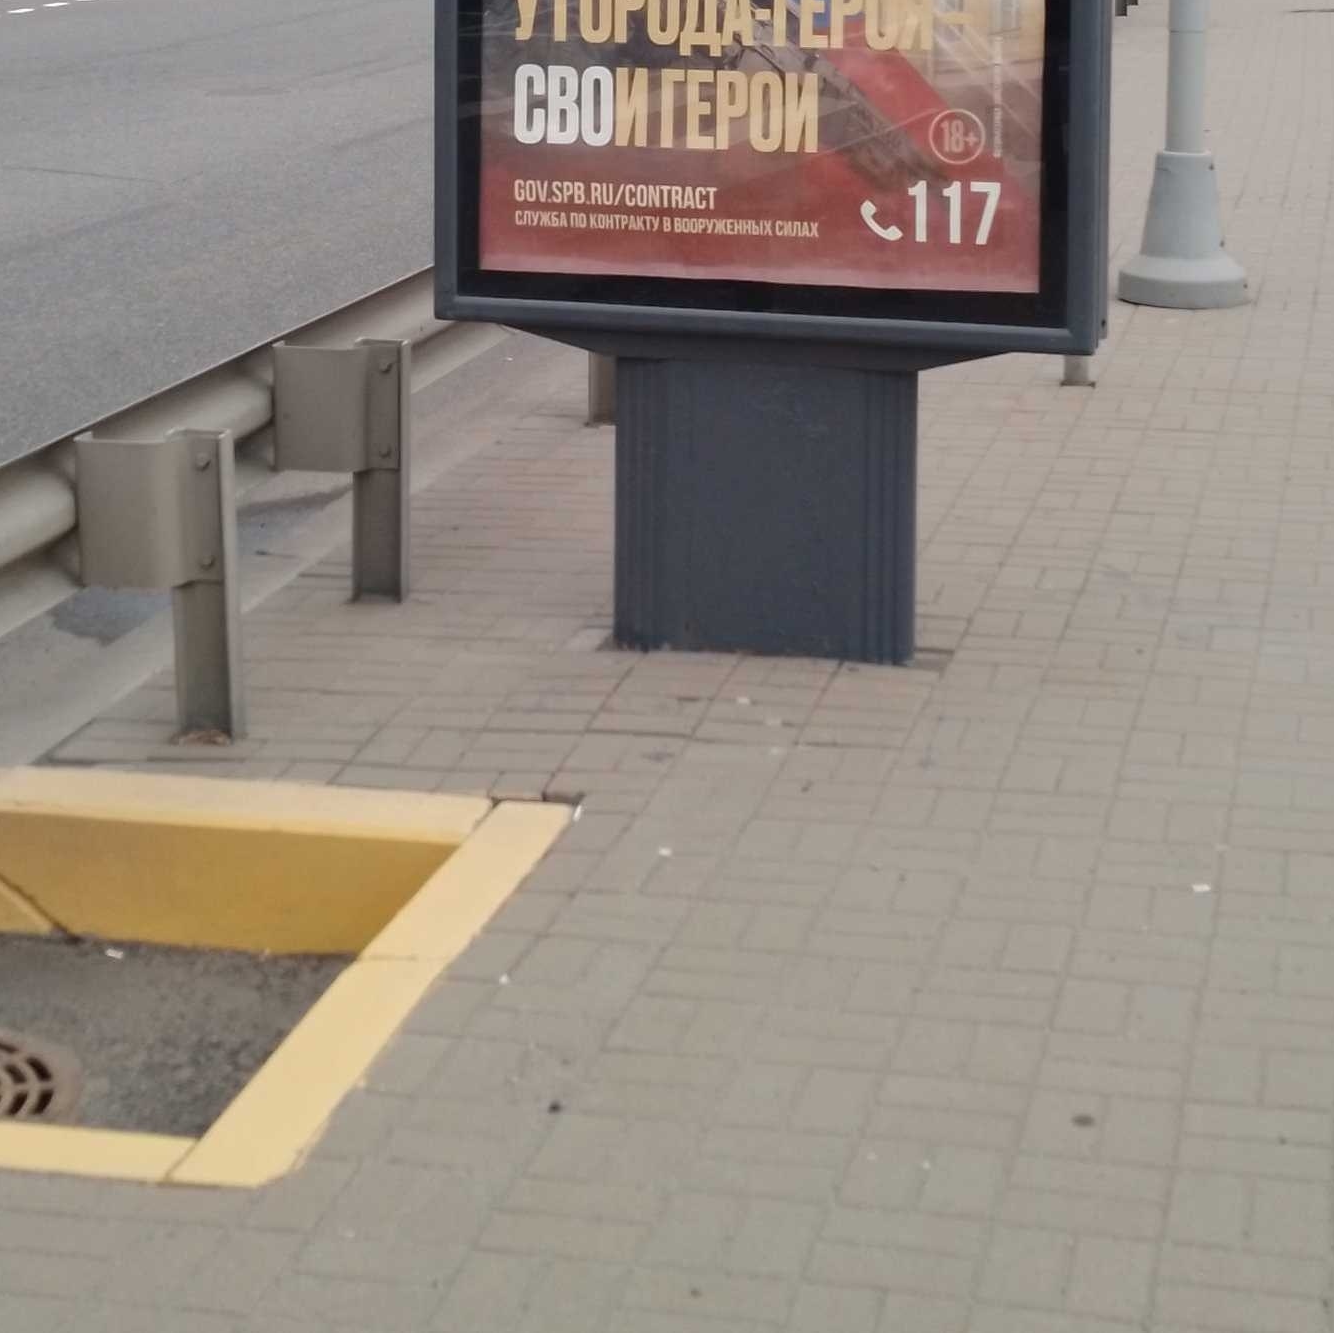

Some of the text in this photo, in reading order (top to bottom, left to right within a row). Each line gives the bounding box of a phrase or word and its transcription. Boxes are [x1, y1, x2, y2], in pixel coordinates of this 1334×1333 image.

[514, 64, 818, 153] СВОИ ГЕРОИ
[938, 119, 980, 155] 18+
[514, 179, 717, 210] GOV.SPB.RU/CONTRACT
[515, 210, 820, 238] СЛУЖБА ПО КОНТРАКТУ В ВООРУЖЕННЫХ СИЛАХ
[908, 181, 1002, 246] 117
